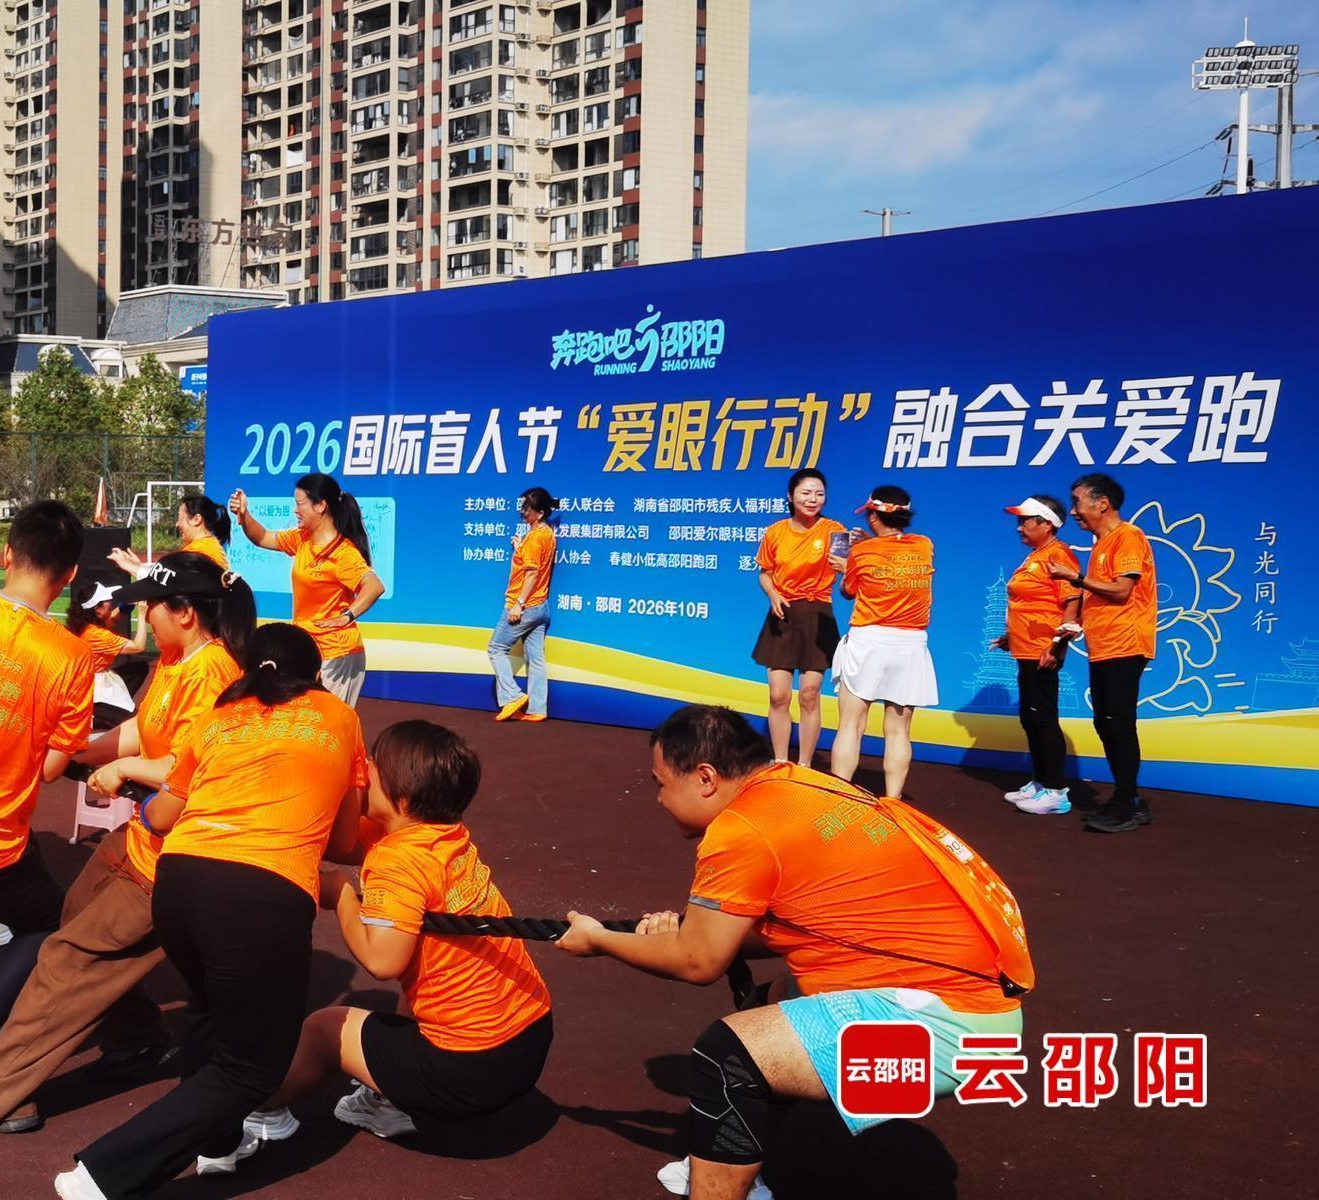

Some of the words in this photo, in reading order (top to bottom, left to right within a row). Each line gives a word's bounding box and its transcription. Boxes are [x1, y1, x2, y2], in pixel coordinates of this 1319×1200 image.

[550, 329, 636, 371] 奔跑吧
[660, 318, 725, 359] 邵阳
[593, 362, 638, 376] RUNNING
[661, 357, 717, 372] SHAOYANG
[609, 551, 718, 570] 春健小低高邵阳跑团
[1251, 521, 1279, 634] 与光同行
[627, 598, 710, 619] 2026年10月
